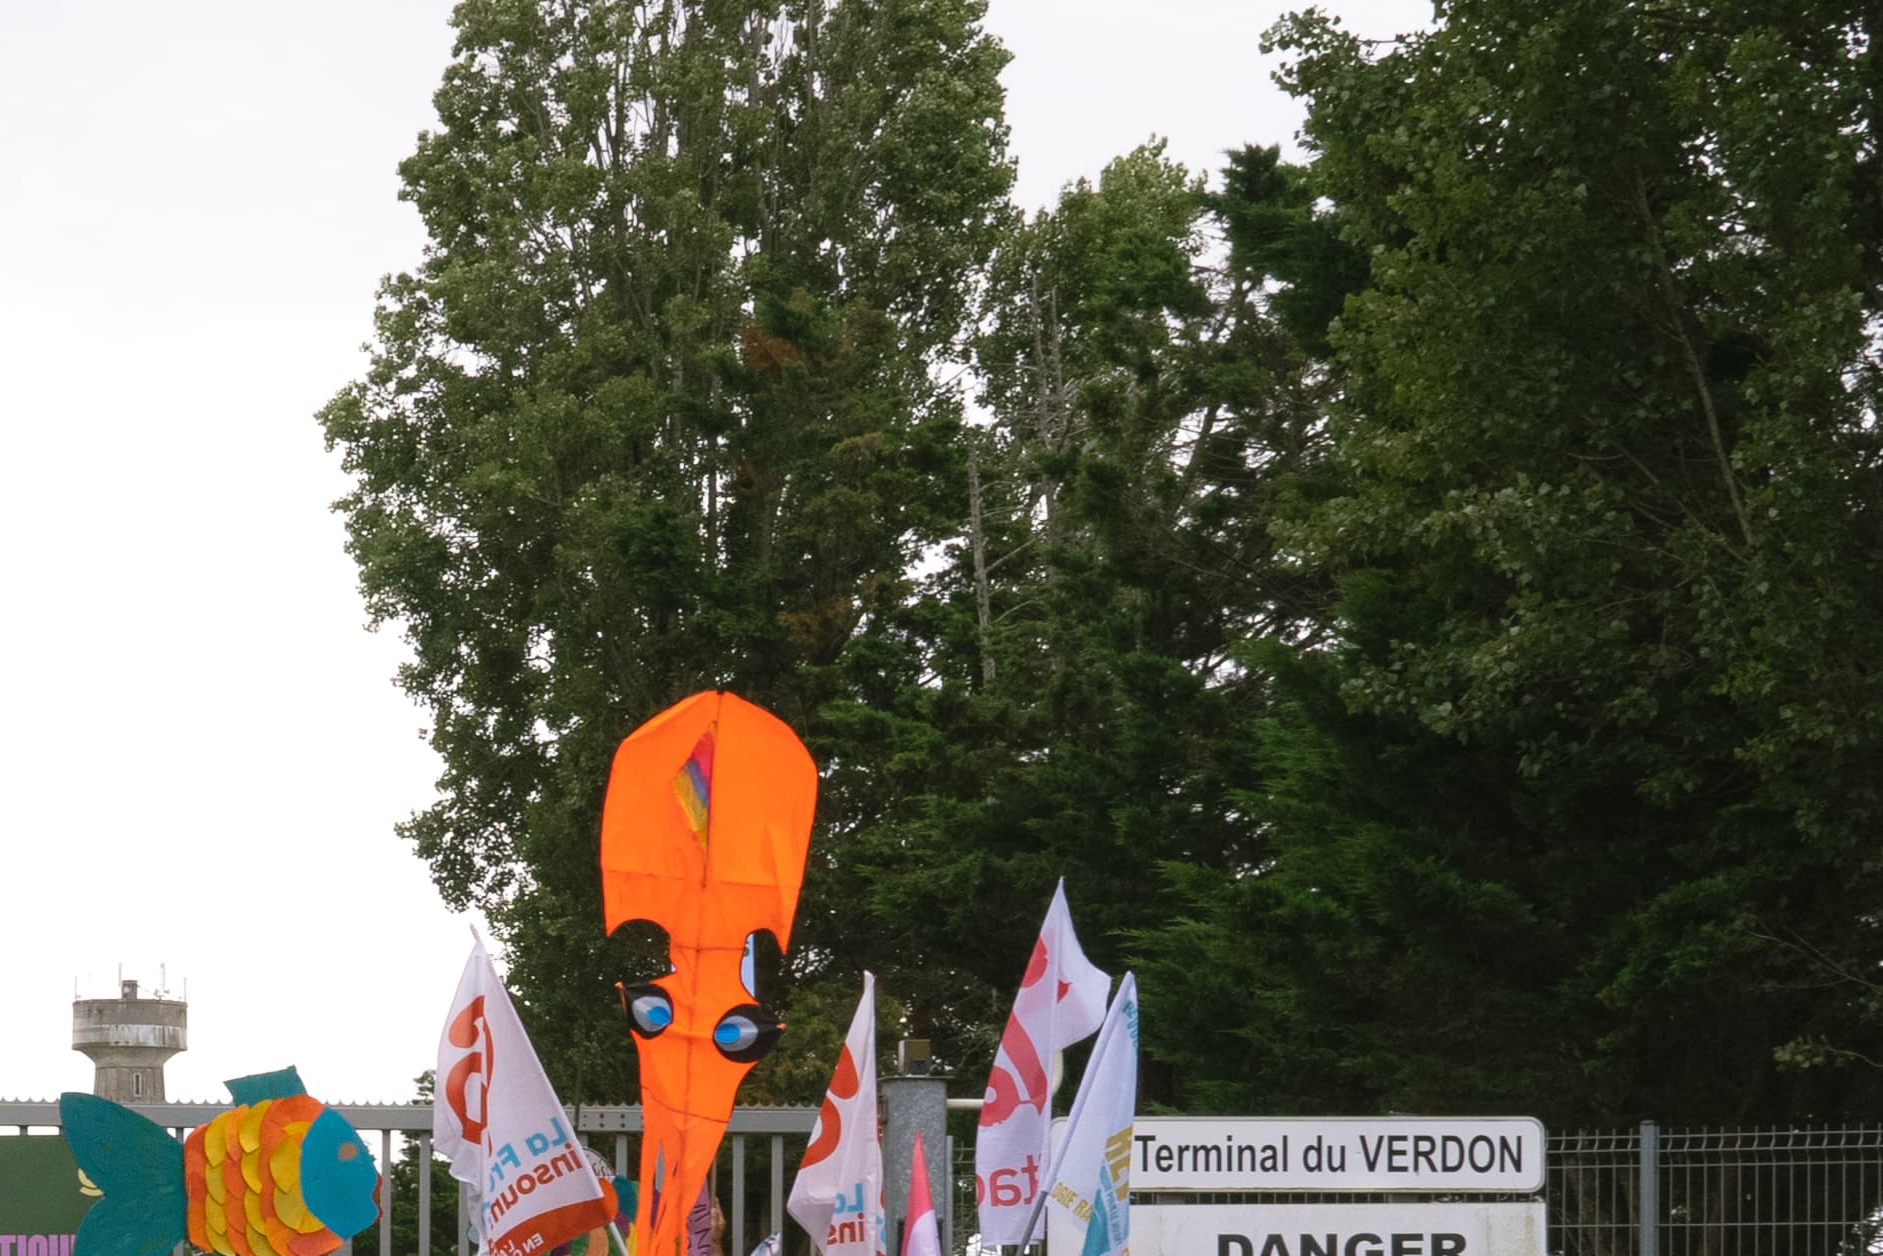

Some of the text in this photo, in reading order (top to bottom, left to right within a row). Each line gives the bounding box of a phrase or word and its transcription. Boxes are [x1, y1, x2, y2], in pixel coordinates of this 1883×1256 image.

[1134, 1134, 1523, 1175] Terminal du VERDON
